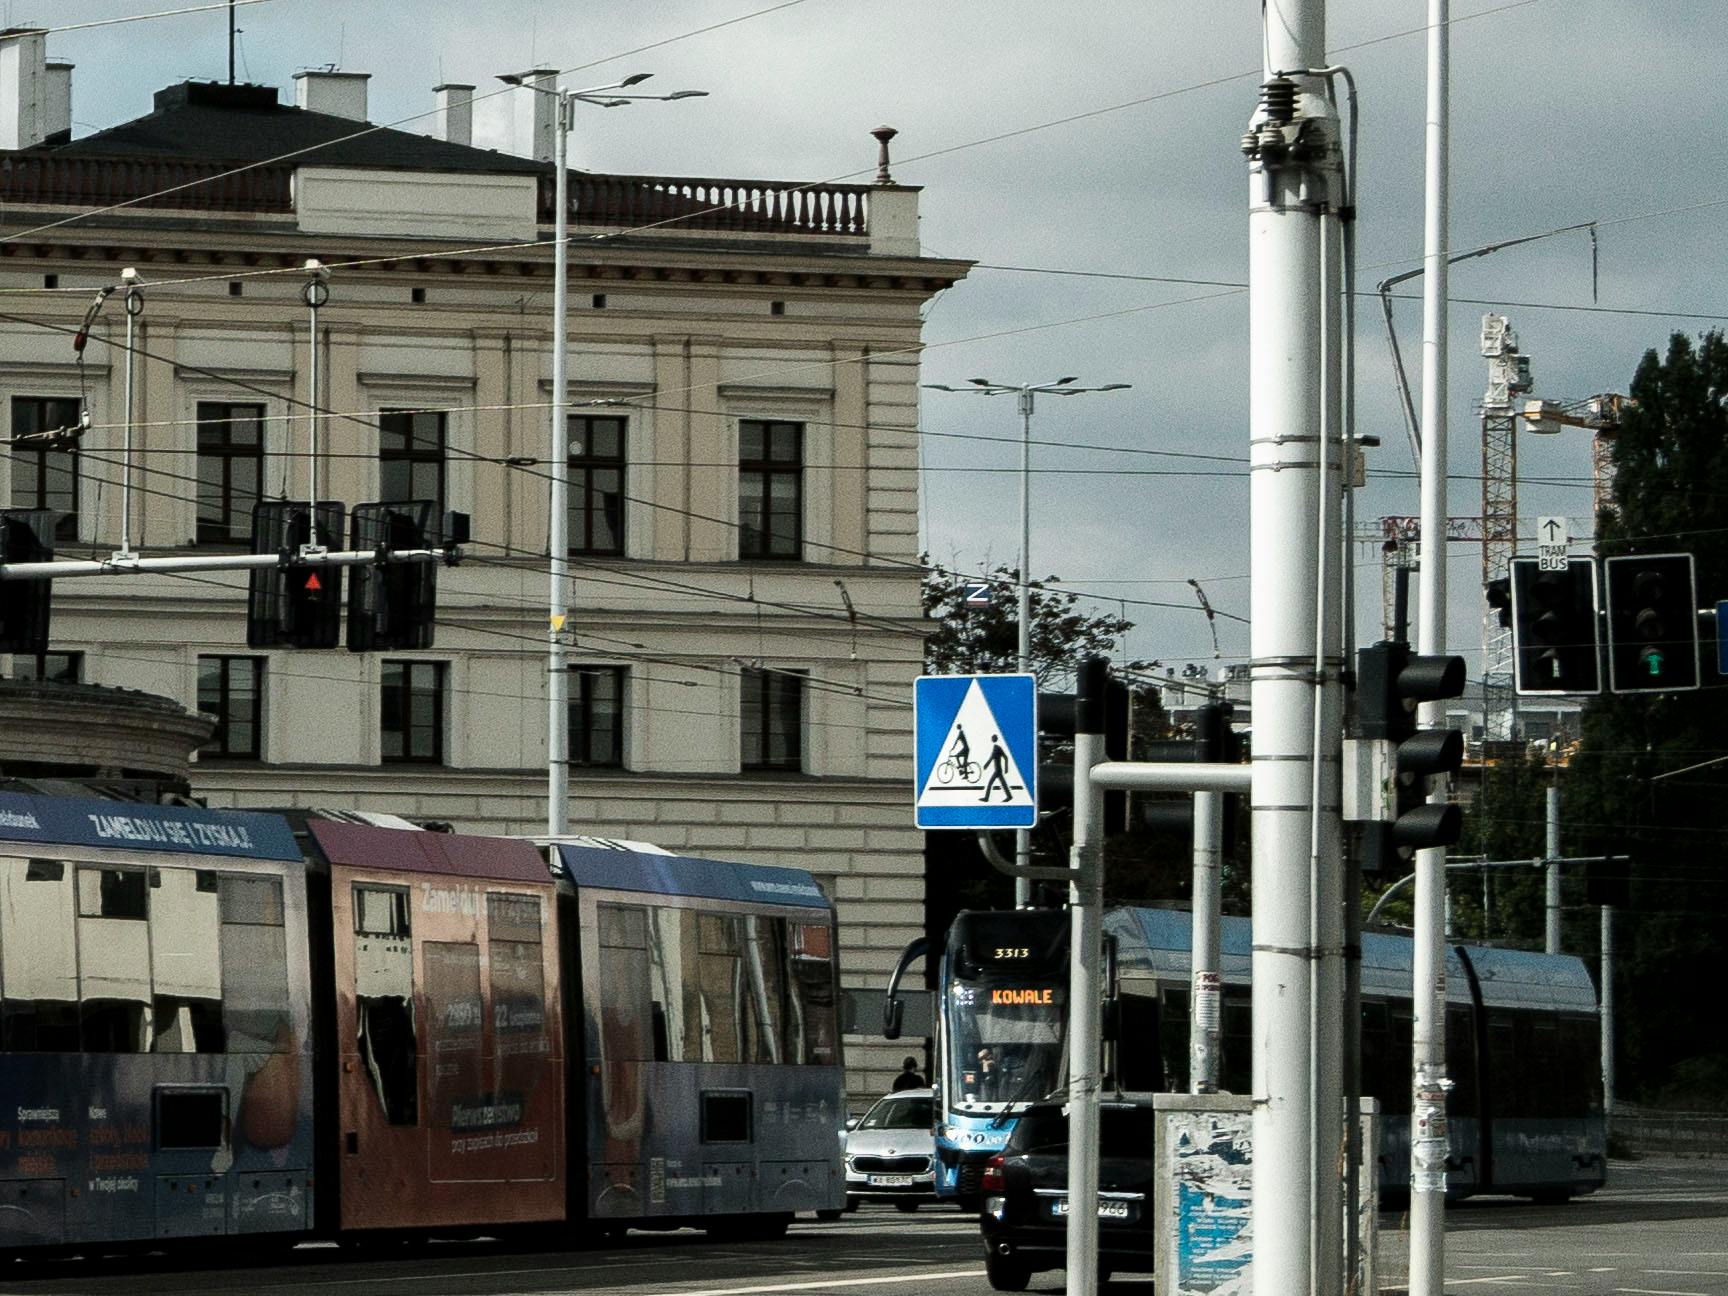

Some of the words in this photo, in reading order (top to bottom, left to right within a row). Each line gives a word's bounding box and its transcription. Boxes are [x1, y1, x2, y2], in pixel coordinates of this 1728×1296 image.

[1539, 545, 1566, 557] TRAM
[1541, 558, 1567, 570] BUS
[994, 948, 1029, 959] 3313
[992, 989, 1053, 1005] KOWALE
